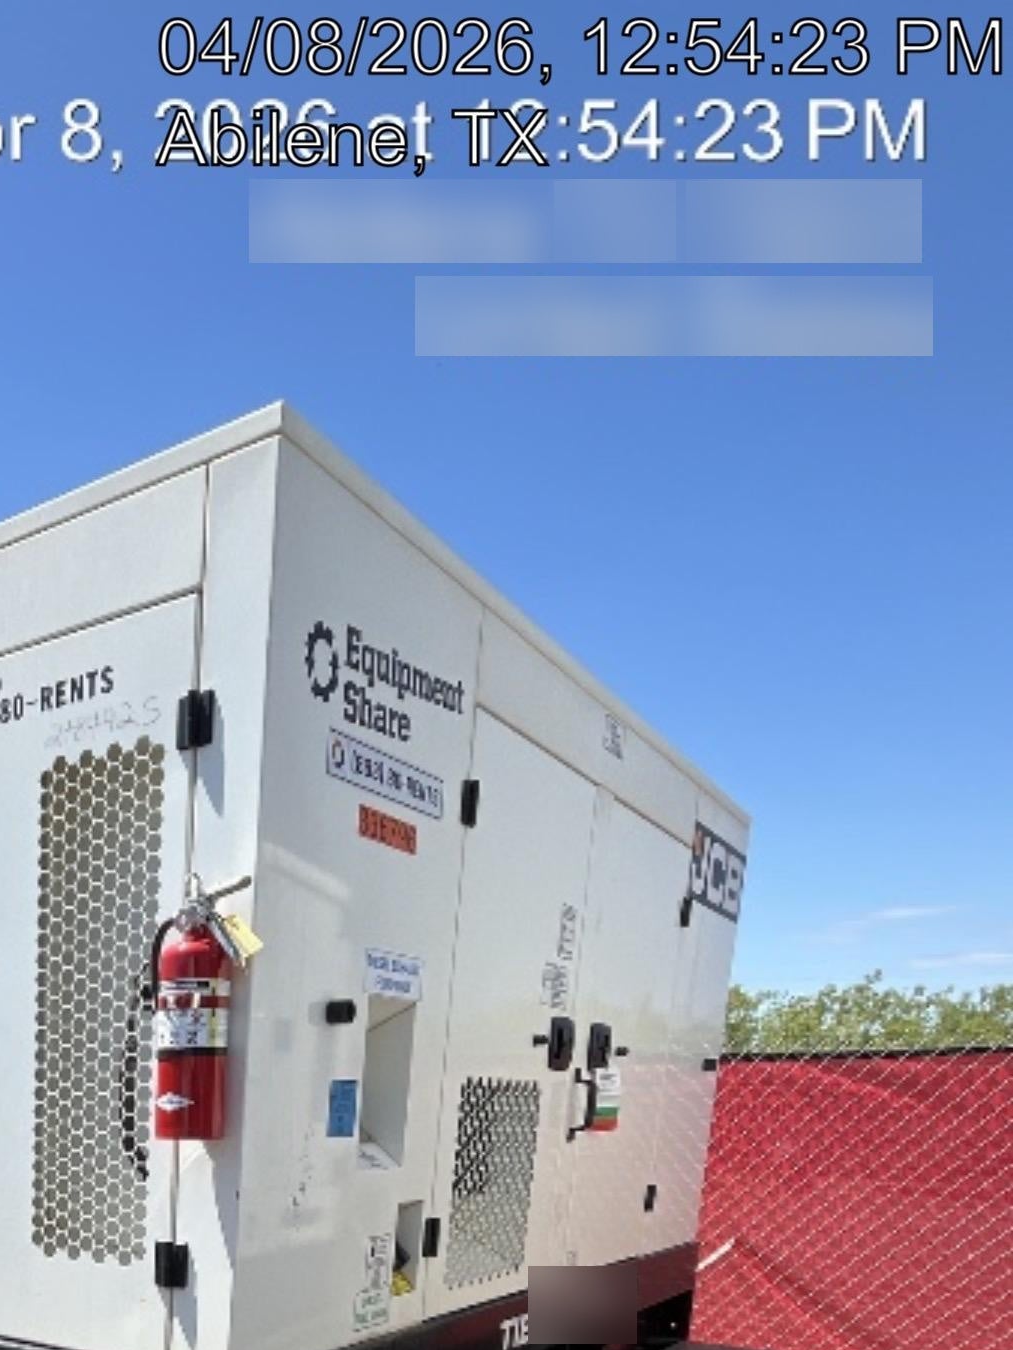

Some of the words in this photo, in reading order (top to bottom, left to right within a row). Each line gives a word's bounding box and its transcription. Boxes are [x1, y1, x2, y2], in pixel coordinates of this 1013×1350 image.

[345, 624, 464, 714] Equipment
[343, 680, 411, 742] Share
[690, 833, 743, 914] JCB
